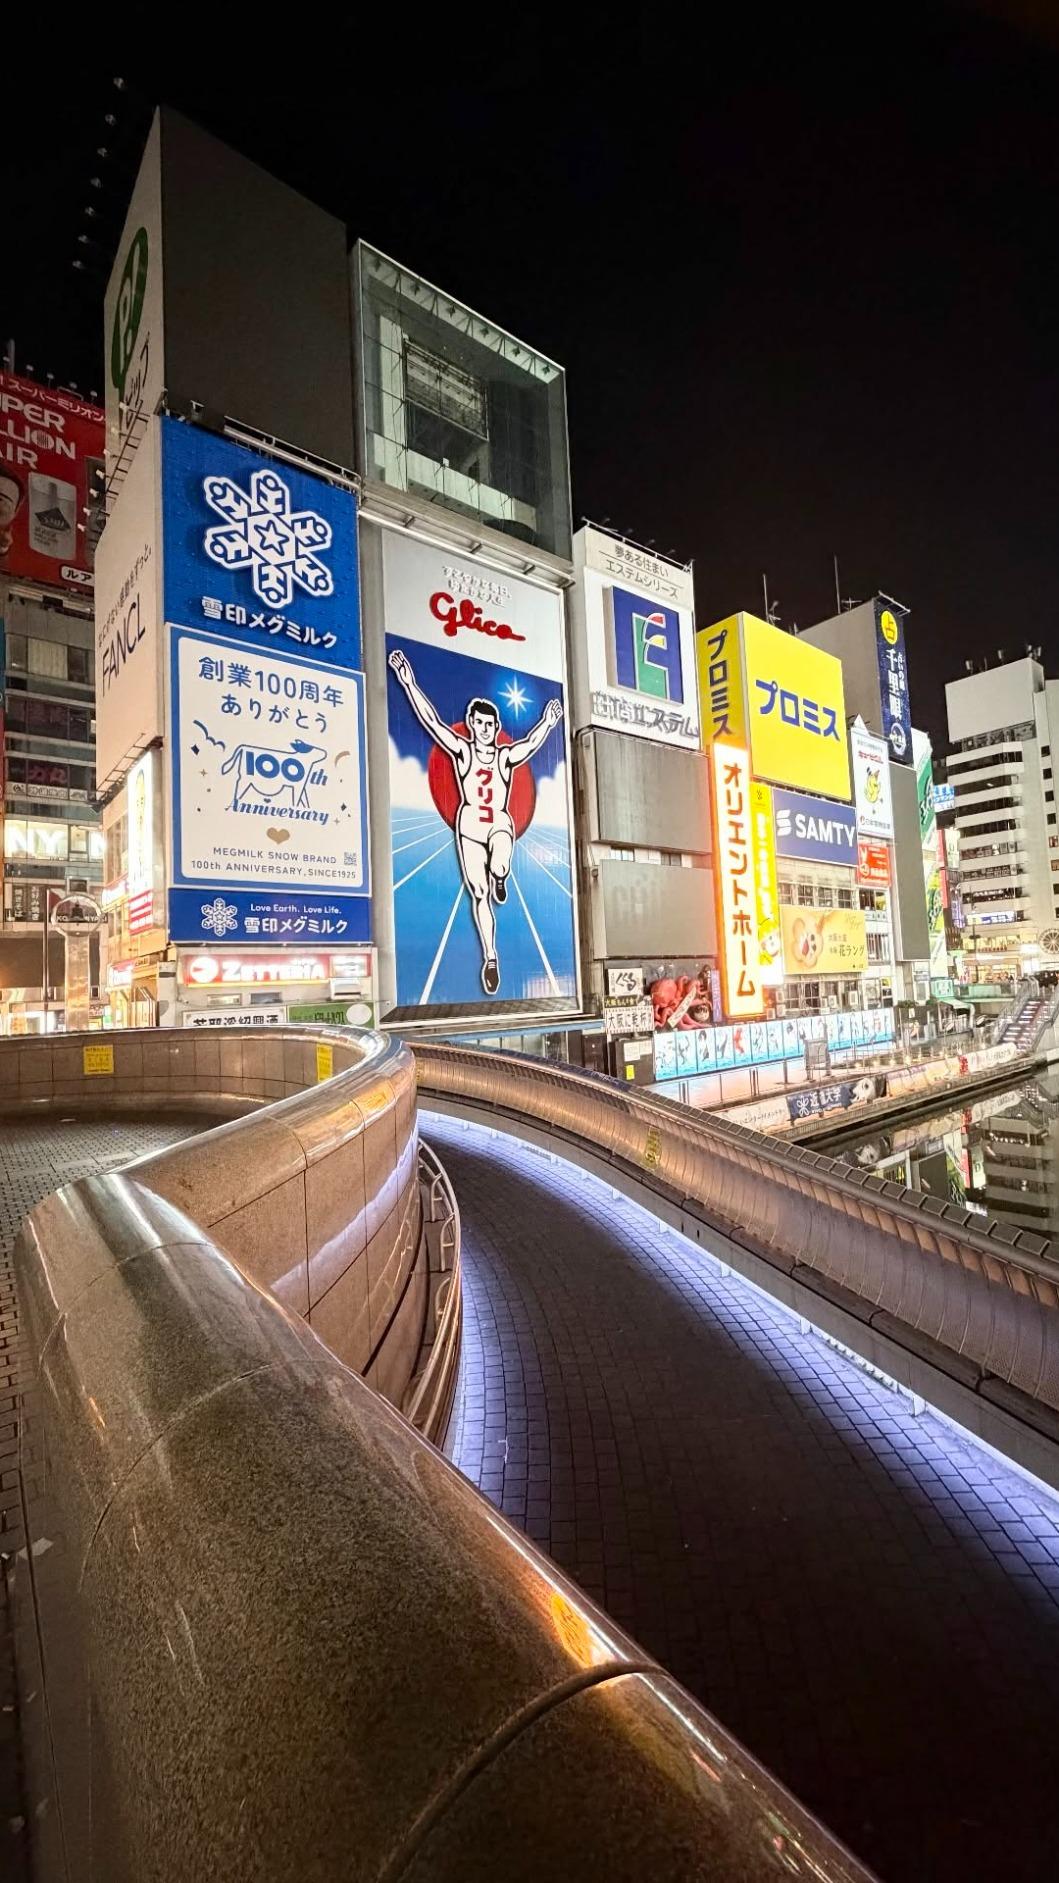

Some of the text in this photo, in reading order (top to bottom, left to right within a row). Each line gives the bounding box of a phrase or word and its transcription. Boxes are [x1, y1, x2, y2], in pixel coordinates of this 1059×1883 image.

[0, 392, 66, 433] PER
[605, 559, 680, 600] エステムシリーズ
[201, 595, 338, 649] 雪印メグミルク
[429, 591, 526, 642] Glico
[102, 591, 147, 698] FANCL
[198, 656, 344, 708] 創業100周年
[707, 629, 733, 739] プロミス
[221, 693, 328, 733] ありがとう
[755, 679, 841, 742] プロミス
[224, 798, 330, 825] Anniversary
[475, 767, 494, 823] グリコ
[795, 813, 856, 848] SAMTY
[191, 860, 221, 871] 100th
[213, 847, 337, 865] MEGMILK SNOW BRAND
[723, 763, 755, 998] オリエントホーム
[244, 916, 348, 934] 雪印メグミルク
[250, 903, 342, 915] Love Earth. Love Life.
